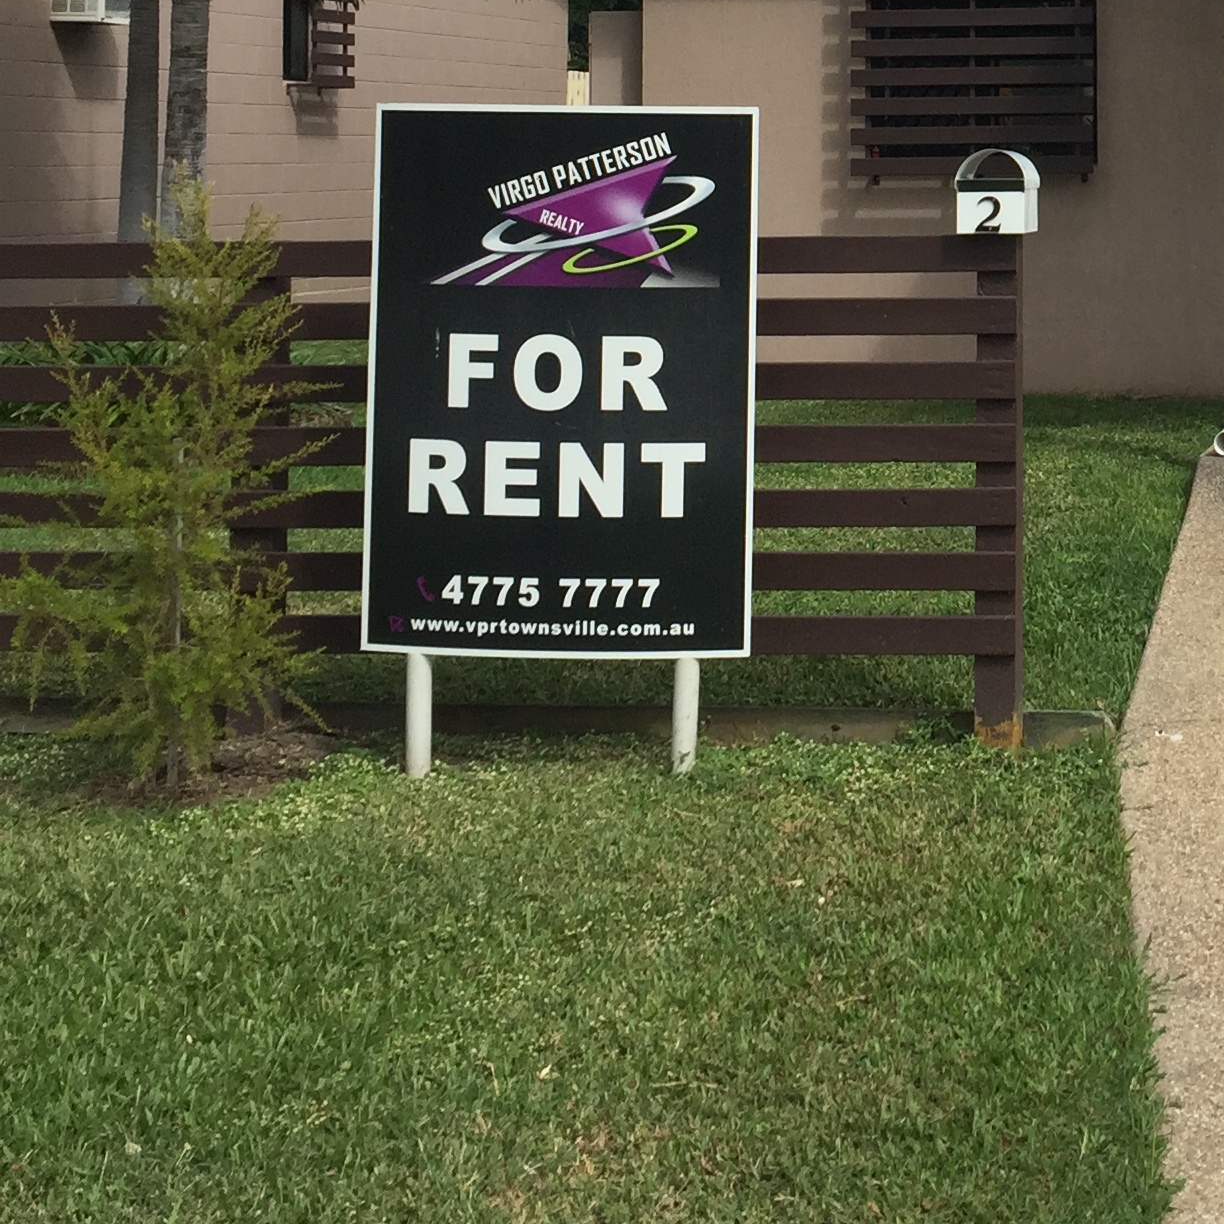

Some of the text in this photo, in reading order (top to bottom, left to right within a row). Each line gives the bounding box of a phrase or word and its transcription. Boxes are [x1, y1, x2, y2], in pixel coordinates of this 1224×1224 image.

[488, 133, 672, 210] VIRGO PATTERSON
[540, 210, 584, 235] REALTY
[975, 196, 1001, 232] 2
[448, 333, 668, 411] FOR
[407, 438, 706, 518] RENT
[441, 575, 661, 608] 4775 7777
[410, 617, 696, 637] www.vprtownsville.com.au
